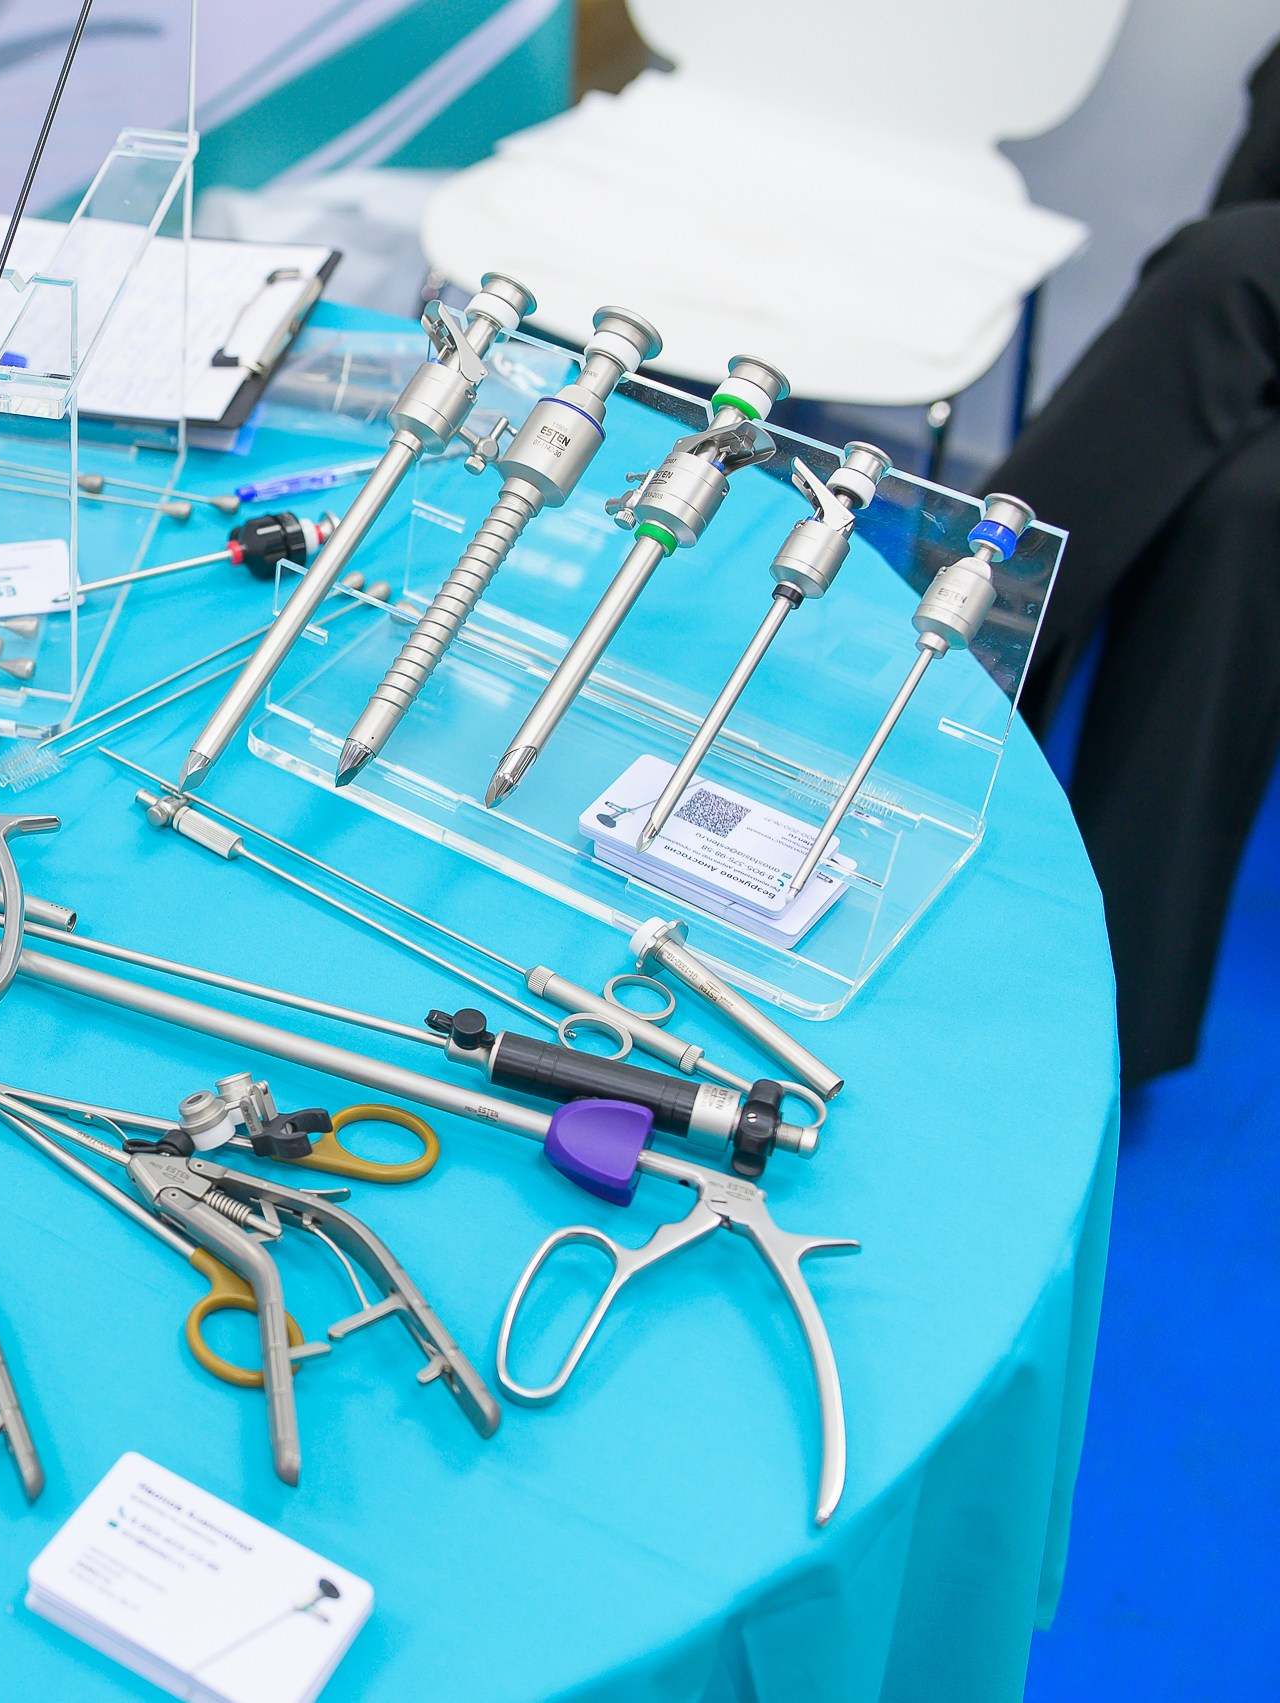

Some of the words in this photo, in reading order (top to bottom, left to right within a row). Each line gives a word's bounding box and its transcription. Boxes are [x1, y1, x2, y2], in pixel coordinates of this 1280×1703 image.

[540, 425, 571, 447] ESTEN
[787, 832, 813, 847] sten.ru
[663, 844, 717, 872] Анастасия
[694, 832, 780, 872] anastasia@esten.ru
[719, 869, 776, 899] Безрукова
[698, 984, 717, 1001] ESTEN
[477, 1105, 499, 1117] ESTEN
[165, 1164, 190, 1179] ESTEN
